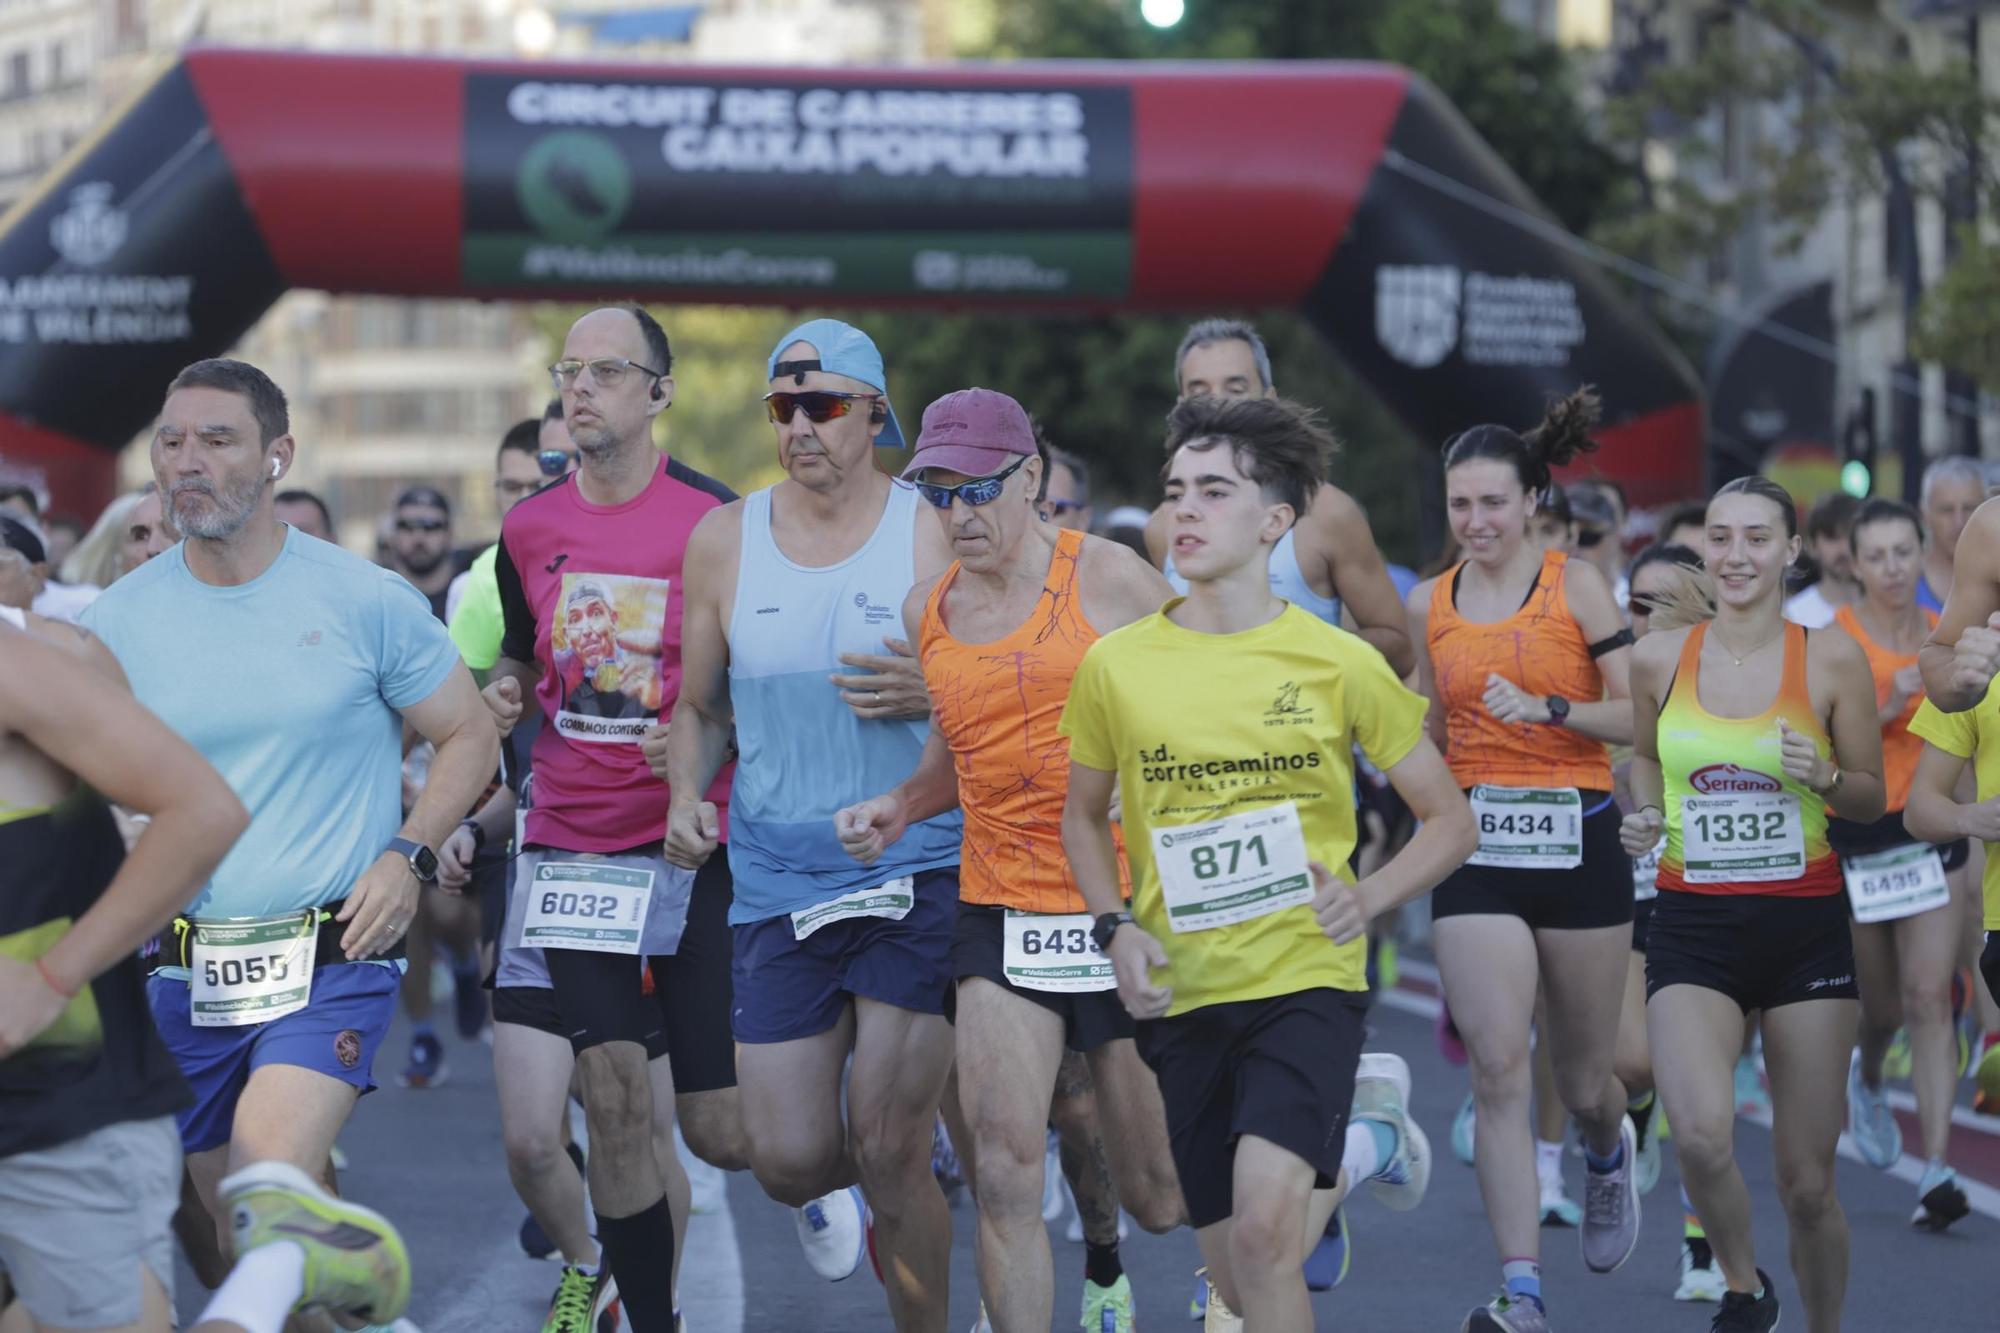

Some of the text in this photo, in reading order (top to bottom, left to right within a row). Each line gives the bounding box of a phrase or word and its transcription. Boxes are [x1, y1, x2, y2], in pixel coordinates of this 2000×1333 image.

[508, 82, 1084, 135] CIRCUIT DE CARRERES
[560, 718, 607, 735] CORREMOS
[1140, 743, 1176, 764] s.d.
[1142, 751, 1321, 783] correcaminos
[1185, 776, 1274, 793] VALENCIA
[1700, 774, 1774, 792] Serrano
[1481, 813, 1554, 834] 6434
[1694, 811, 1787, 842] 1332
[1190, 834, 1269, 880] 871
[1862, 867, 1922, 896] 6435
[541, 892, 618, 920] 6032
[205, 954, 288, 987] 5055
